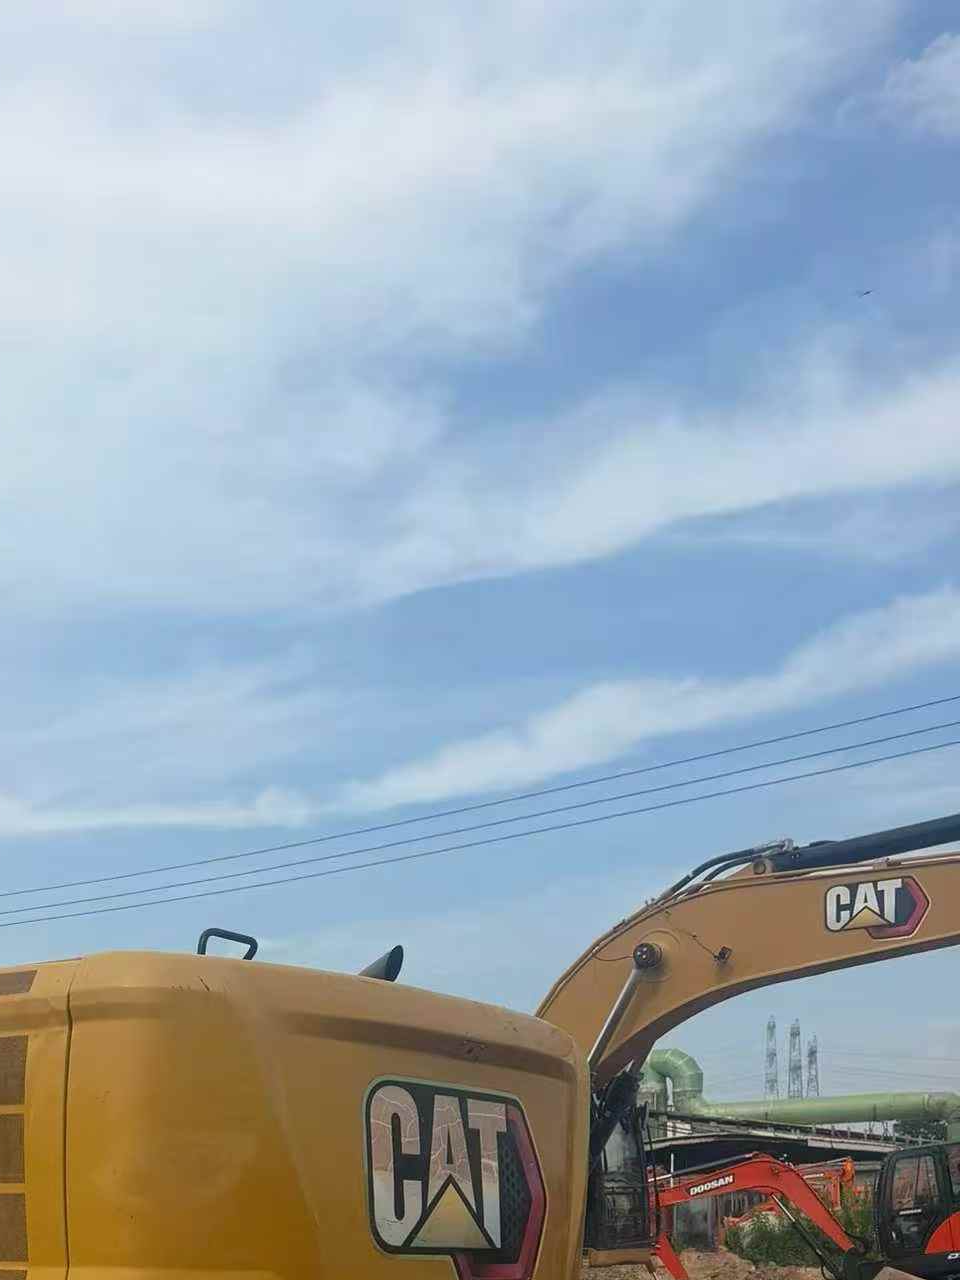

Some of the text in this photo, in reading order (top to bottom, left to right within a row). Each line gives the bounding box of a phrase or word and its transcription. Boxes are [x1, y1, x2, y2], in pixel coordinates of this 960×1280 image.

[826, 878, 902, 931] CAT
[370, 1085, 508, 1249] CAT
[689, 1175, 734, 1196] DOOSAN
